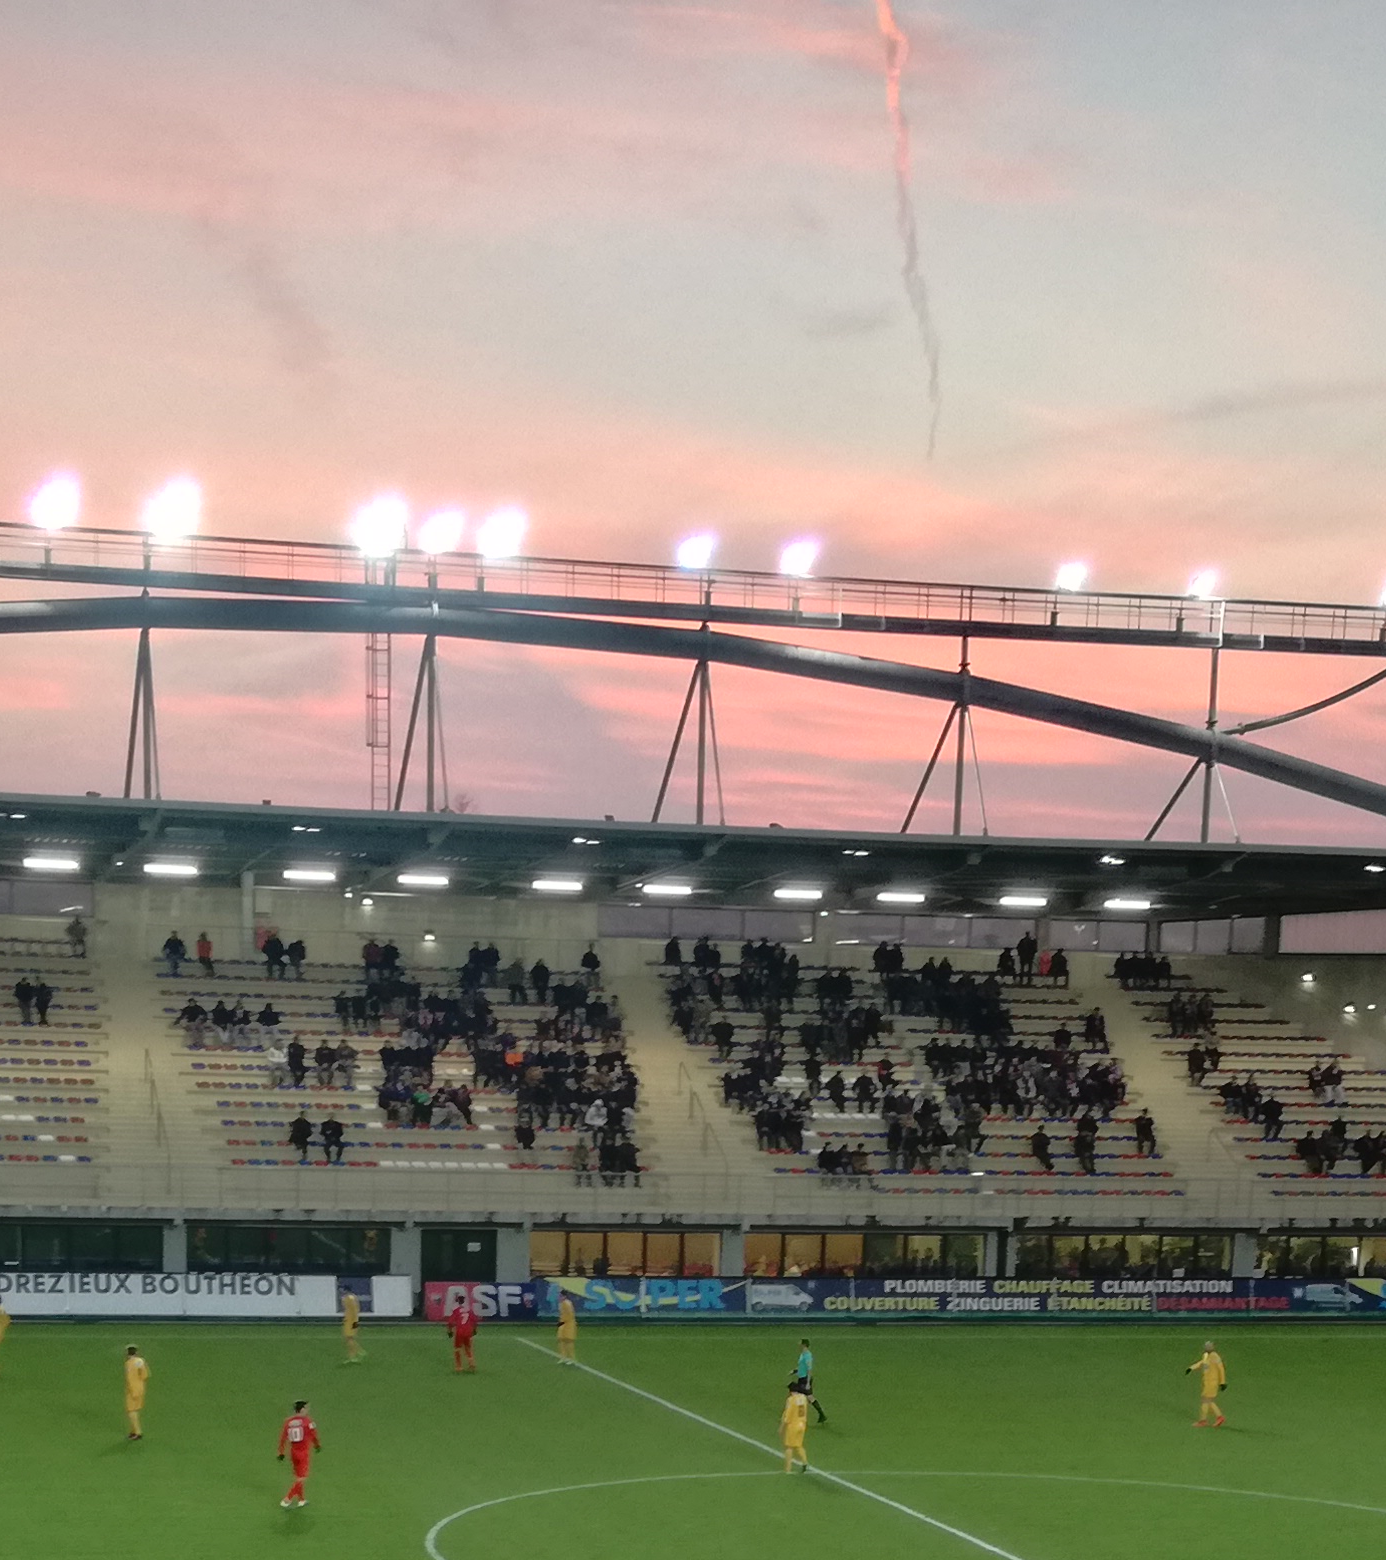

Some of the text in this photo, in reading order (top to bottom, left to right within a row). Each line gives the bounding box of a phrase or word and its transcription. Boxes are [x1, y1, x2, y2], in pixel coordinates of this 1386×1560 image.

[141, 1273, 296, 1296] BOUTHEON
[583, 1279, 725, 1310] SUPER
[884, 1279, 1234, 1294] PLOMBERIE CHAUFFAGE CLIMATISATION
[443, 1284, 522, 1317] ASF
[823, 1296, 940, 1311] COUVERTURE
[946, 1297, 1041, 1311] ZINGUERIE
